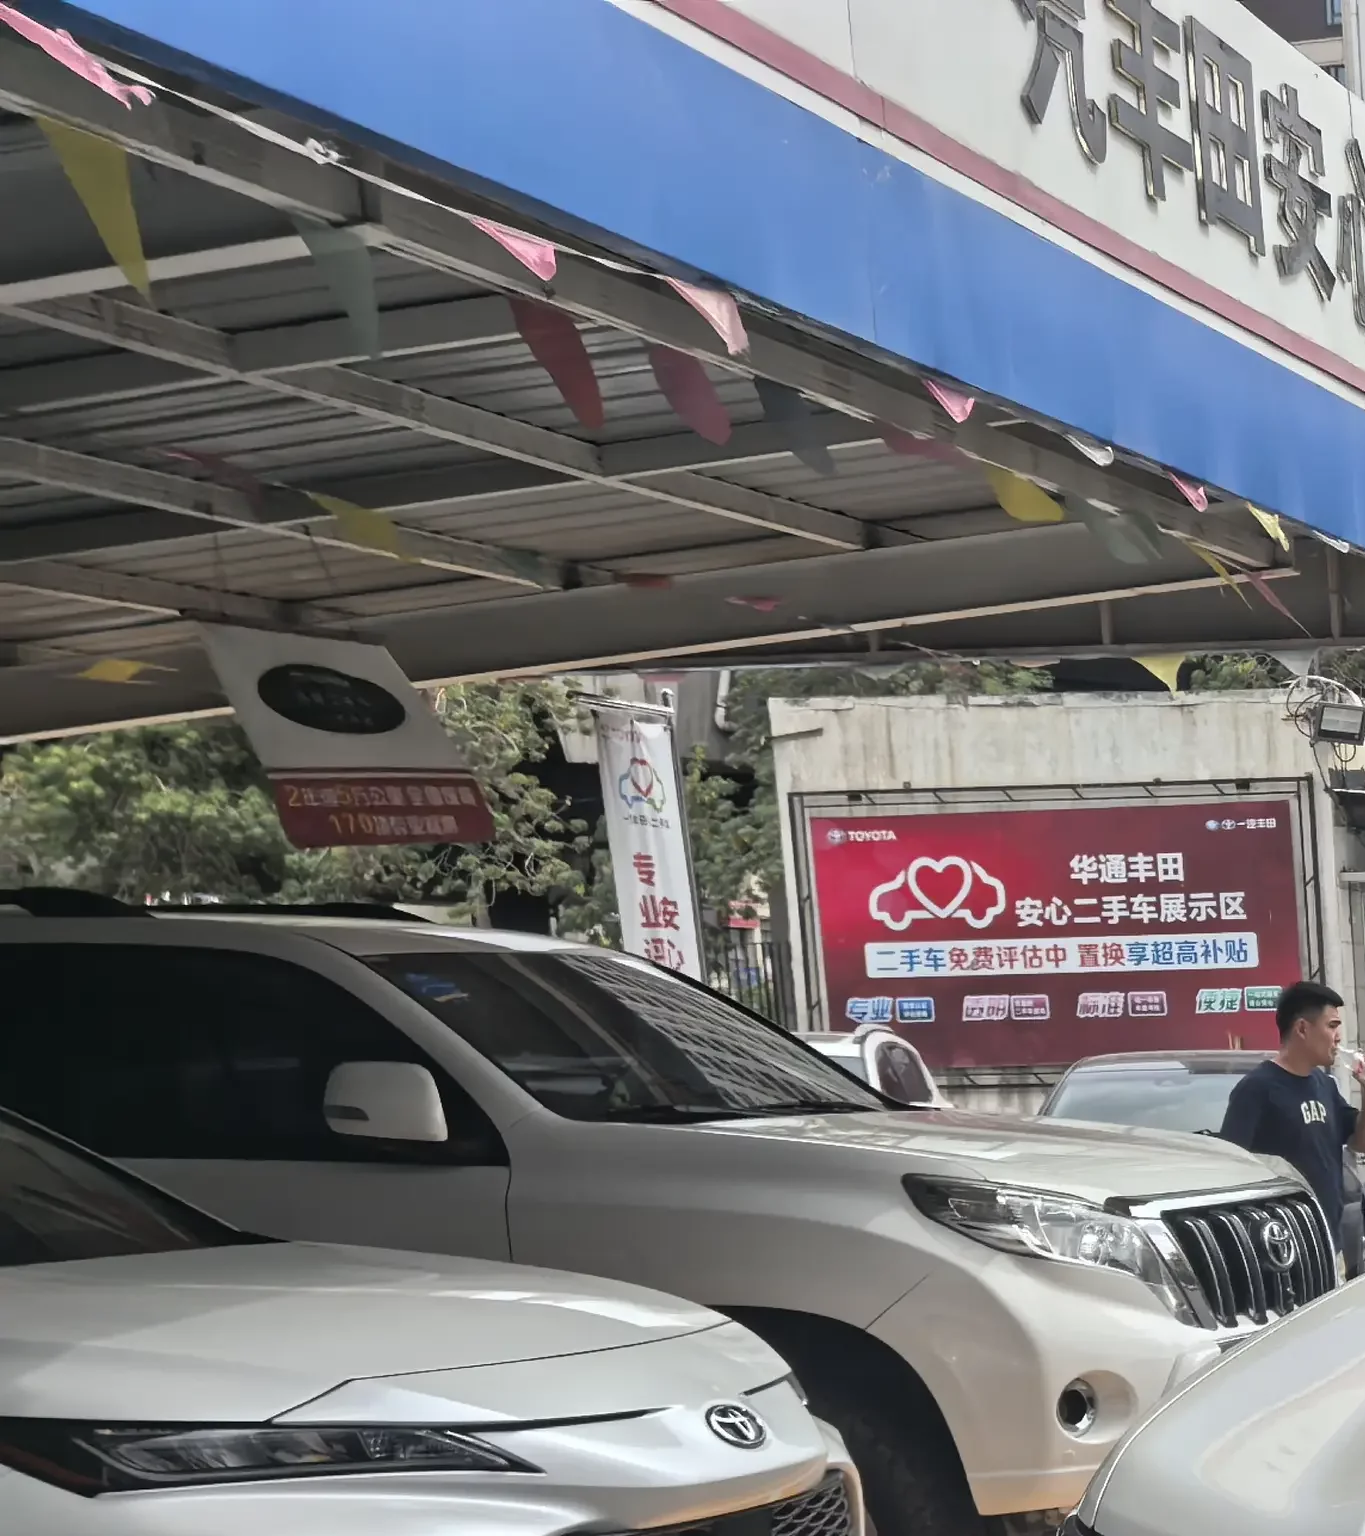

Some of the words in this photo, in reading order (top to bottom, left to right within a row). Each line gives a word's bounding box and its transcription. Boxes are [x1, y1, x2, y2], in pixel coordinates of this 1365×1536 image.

[847, 829, 898, 843] TOYOTA
[1069, 852, 1186, 885] 华通丰田
[1014, 891, 1248, 928] 安心二手车展示区
[875, 944, 1068, 973] 二手车免费评估中
[1077, 938, 1250, 968] 置换享超高补贴
[1300, 1100, 1327, 1124] GAP
